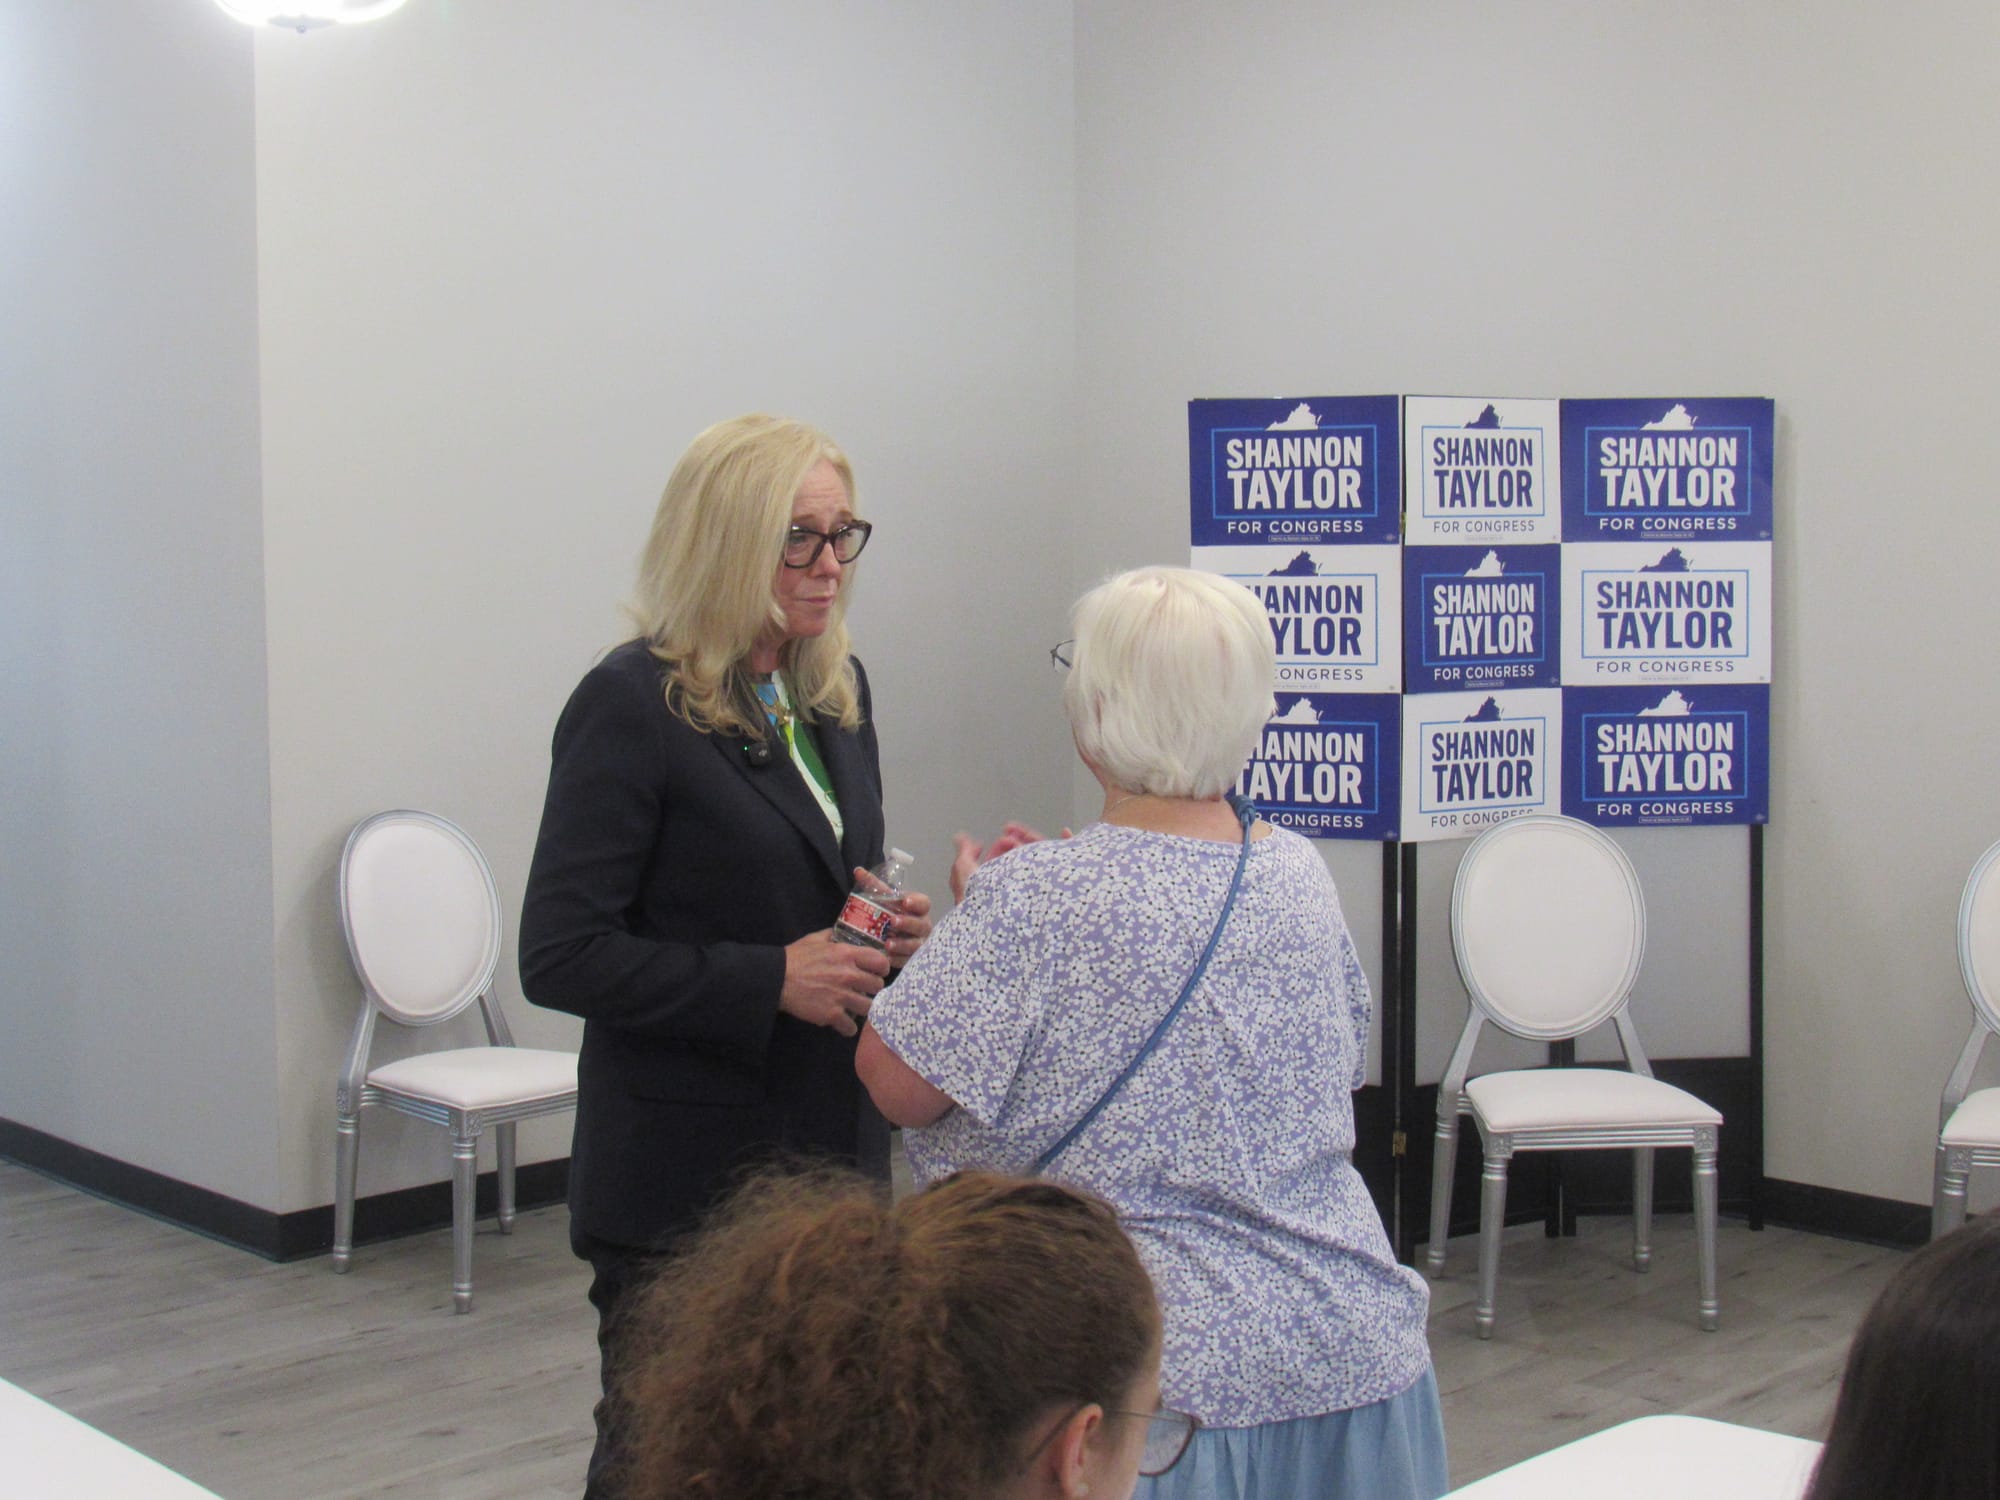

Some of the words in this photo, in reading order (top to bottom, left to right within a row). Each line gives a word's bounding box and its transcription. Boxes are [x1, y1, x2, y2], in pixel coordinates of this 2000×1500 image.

[1226, 436, 1363, 468] SHANNON
[1433, 437, 1533, 467] SHANNON
[1600, 437, 1737, 467] SHANNON
[1227, 468, 1362, 510] TAYLOR
[1433, 469, 1533, 508] TAYLOR
[1600, 468, 1736, 507] TAYLOR
[1227, 521, 1262, 534] FOR
[1269, 520, 1363, 533] CONGRESS
[1433, 521, 1460, 533] FOR
[1465, 519, 1535, 532] CONGRESS
[1600, 518, 1635, 530] FOR
[1642, 517, 1737, 530] CONGRESS
[1246, 585, 1363, 614] ANNON
[1433, 583, 1535, 615] SHANNON
[1597, 580, 1734, 609] SHANNON
[1268, 616, 1362, 656] YLOR
[1433, 614, 1534, 656] TAYLOR
[1597, 611, 1733, 649] TAYLOR
[1274, 668, 1363, 681] ONGRESS
[1434, 667, 1460, 680] FOR
[1465, 664, 1535, 679] CONGRESS
[1596, 661, 1631, 673] FOR
[1639, 660, 1734, 672] CONGRESS
[1432, 728, 1534, 762] SHANNON
[1597, 722, 1733, 752] SHANNON
[1432, 759, 1533, 803] TAYLOR
[1597, 752, 1733, 792] TAYLOR
[1270, 812, 1364, 828] CONGRESS
[1431, 815, 1457, 828] FOR
[1597, 803, 1632, 816] FOR
[1640, 801, 1734, 815] CONGRESS
